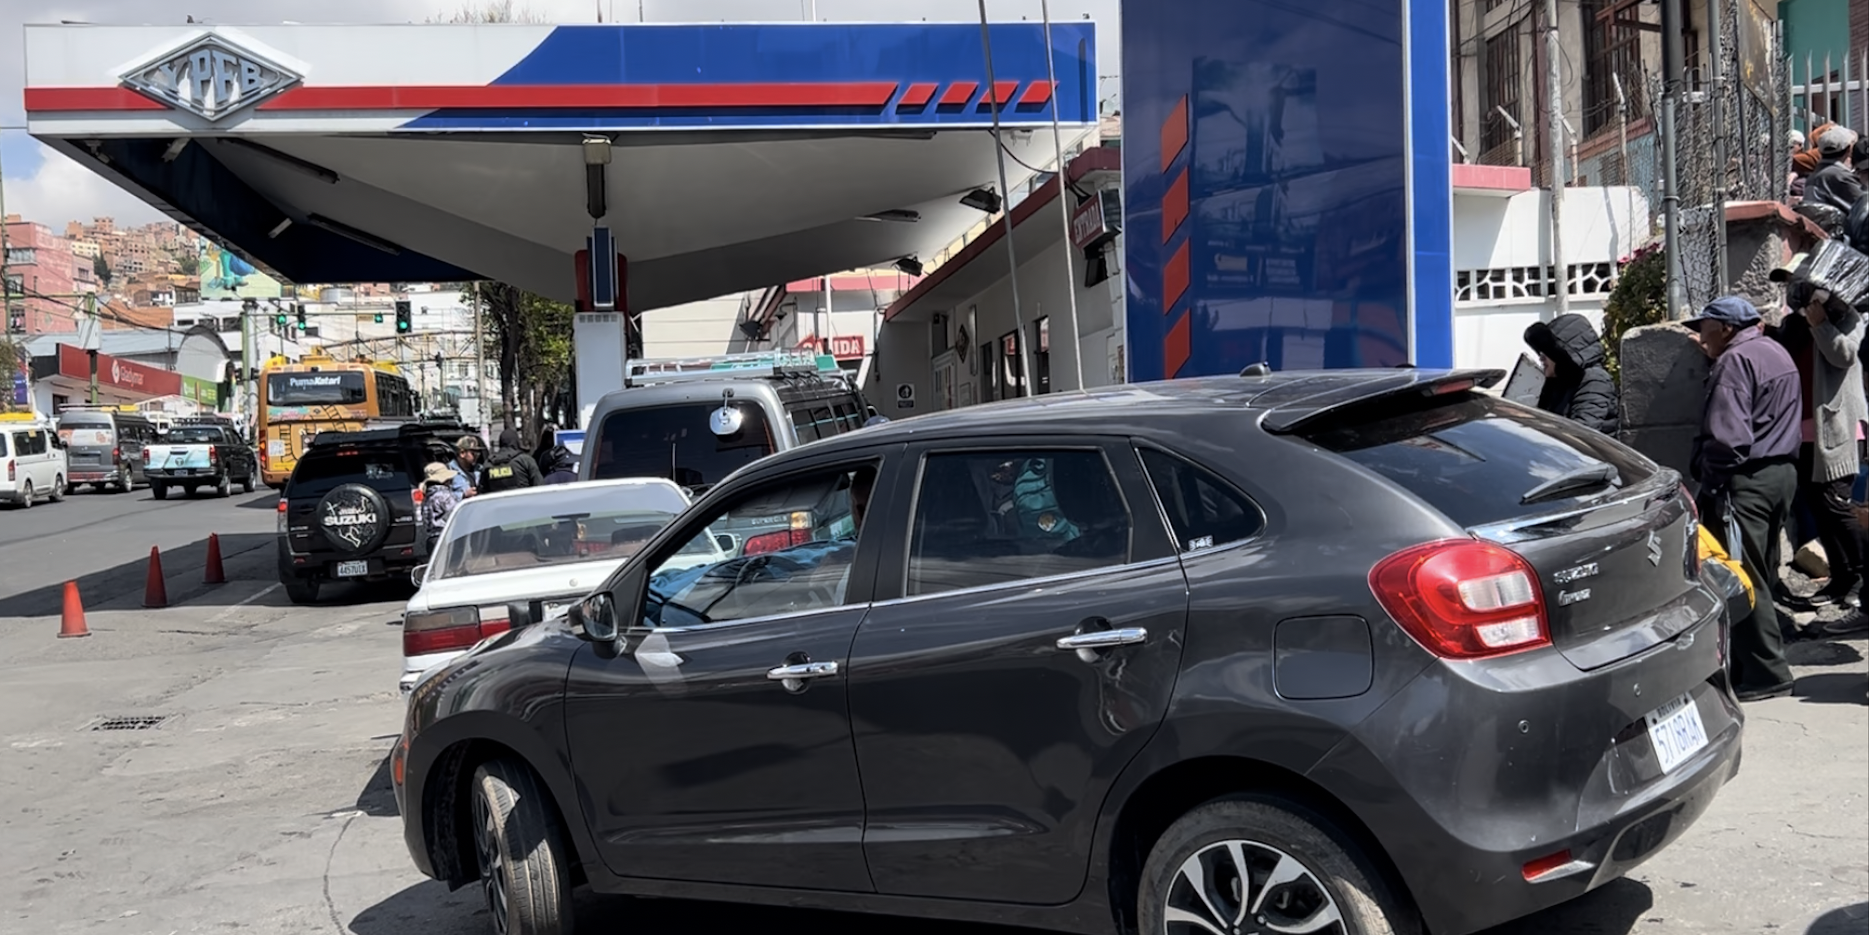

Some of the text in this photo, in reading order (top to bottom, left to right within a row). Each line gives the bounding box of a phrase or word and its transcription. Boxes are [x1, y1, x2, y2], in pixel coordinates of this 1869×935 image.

[159, 49, 263, 101] YPFB
[803, 338, 861, 356] SAIDA
[323, 513, 377, 527] SUZUKI
